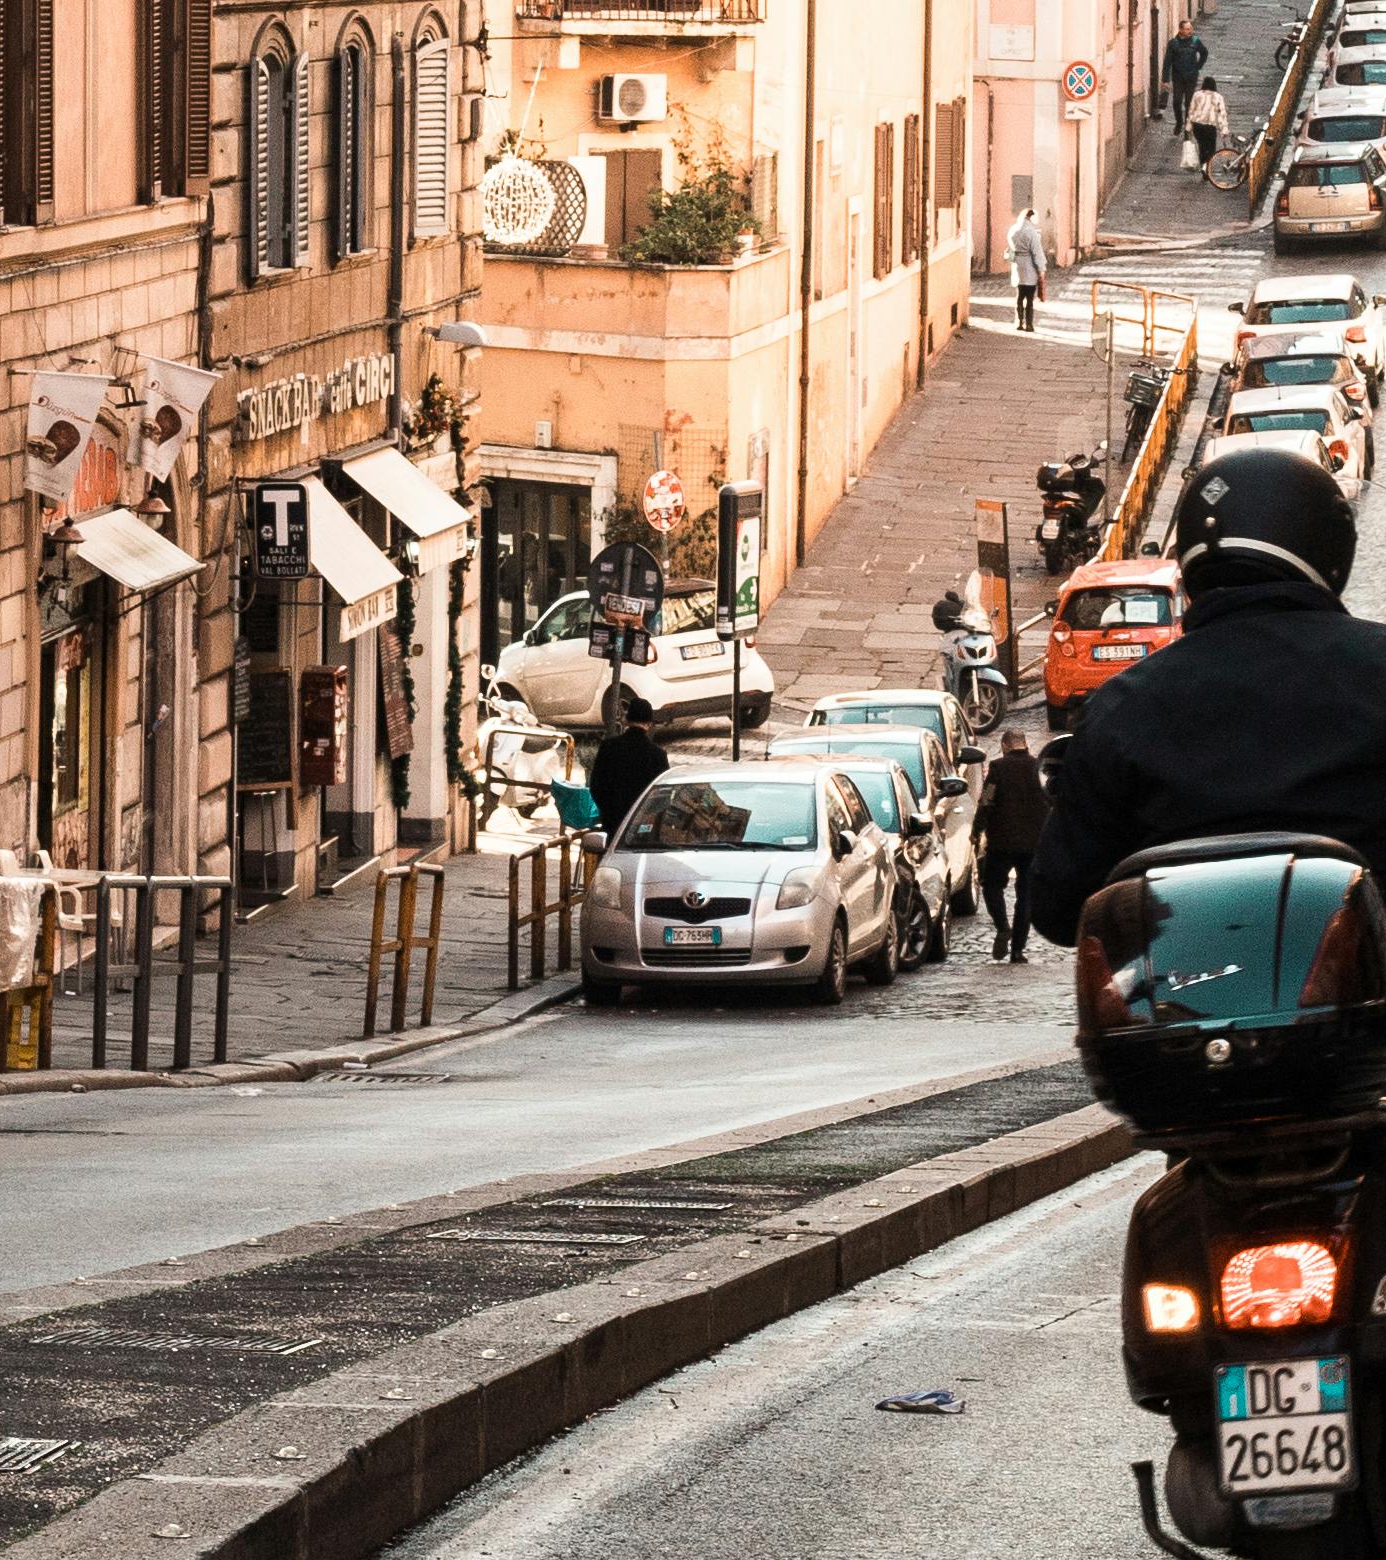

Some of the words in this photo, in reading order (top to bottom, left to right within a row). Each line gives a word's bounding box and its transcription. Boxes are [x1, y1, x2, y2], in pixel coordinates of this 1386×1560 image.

[249, 383, 292, 441] SNACK
[263, 490, 300, 546] T
[261, 555, 305, 564] TABACCHI
[1226, 1425, 1346, 1482] 26648
